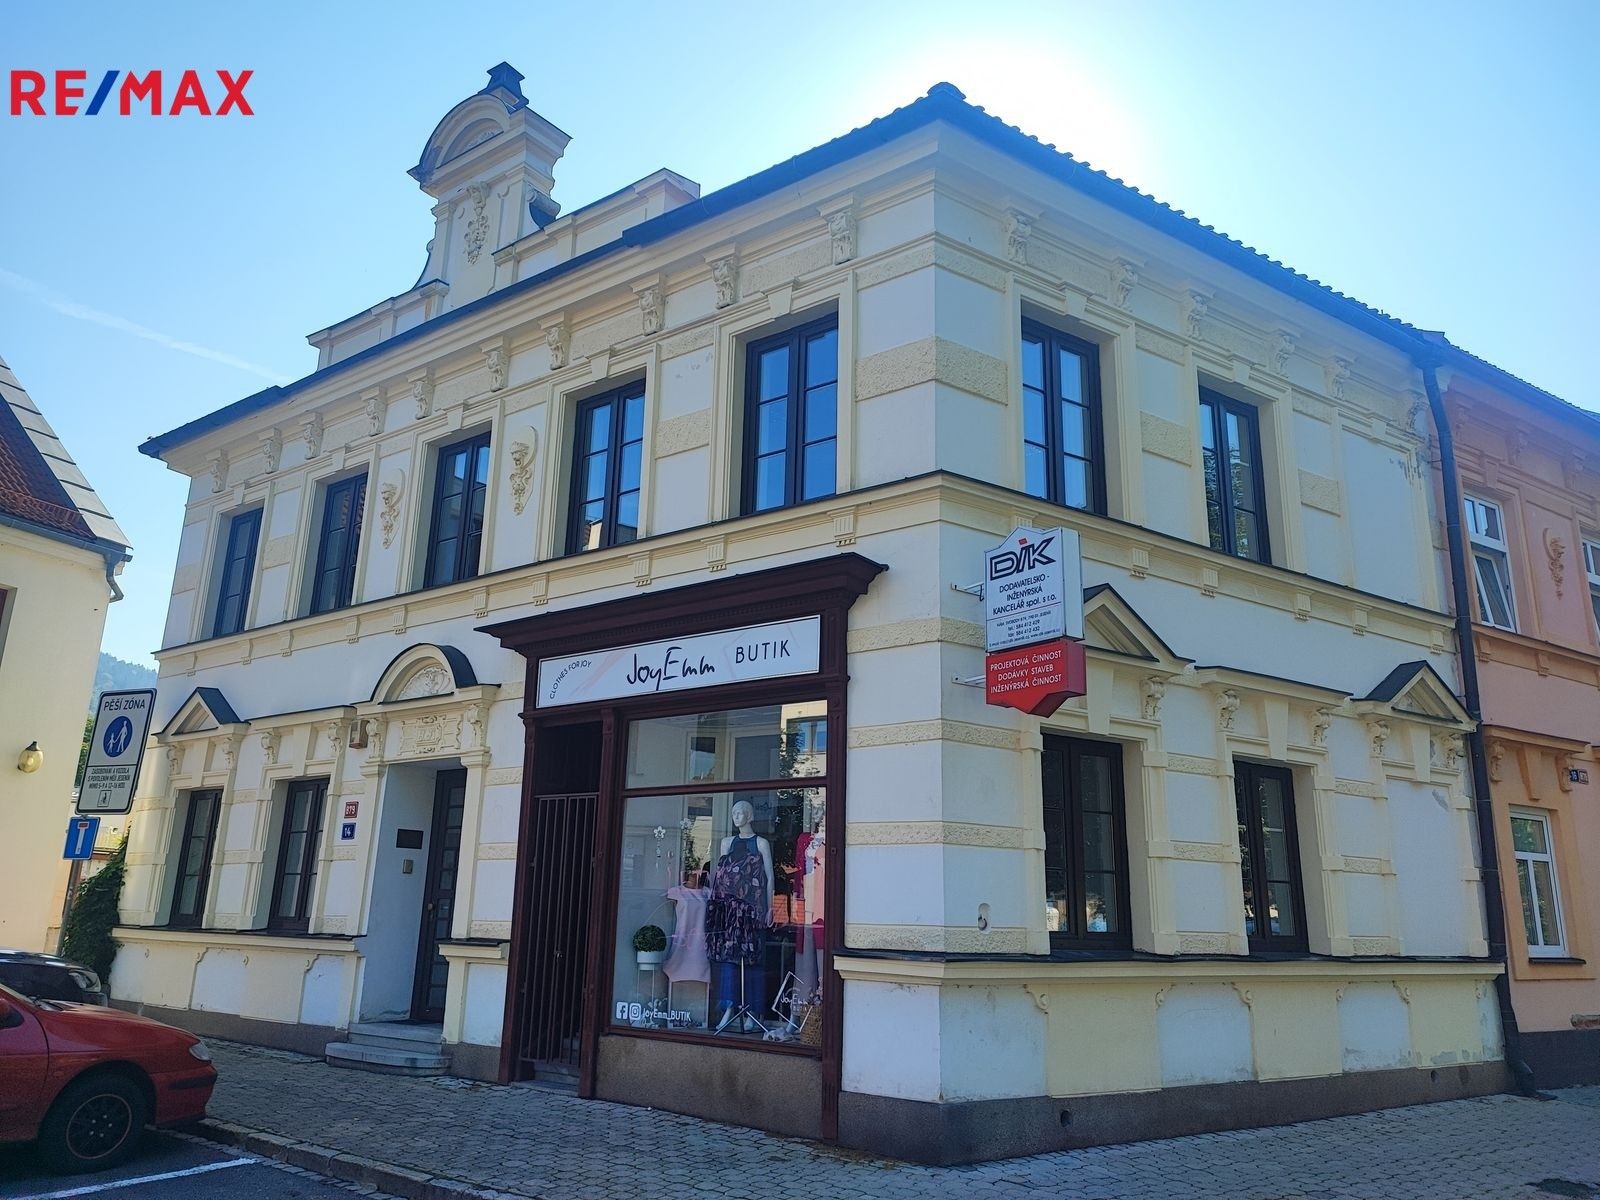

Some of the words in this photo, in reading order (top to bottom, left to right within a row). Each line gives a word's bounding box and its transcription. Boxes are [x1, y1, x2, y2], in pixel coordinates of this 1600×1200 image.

[1000, 573, 1046, 593] DODAVATELSKO
[1007, 584, 1043, 601] INŽENÝRSKÁ
[993, 597, 1025, 615] KANCELÁŘ
[1026, 597, 1041, 607] spol.
[735, 639, 791, 664] BUTIK
[990, 656, 1029, 671] PROJEKTOVÁ
[1032, 650, 1061, 663] ČINNOST
[550, 668, 569, 699] CLOTHES
[568, 661, 580, 670] FOR
[580, 660, 592, 668] JOY
[998, 668, 1029, 681] DODÁVKY
[1031, 664, 1054, 675] STAVEB
[991, 679, 1029, 693] INŽENÝRSKÁ
[1032, 674, 1061, 686] ČINNOST
[104, 698, 123, 711] PĚŠÍ
[123, 697, 145, 710] ZÓNA
